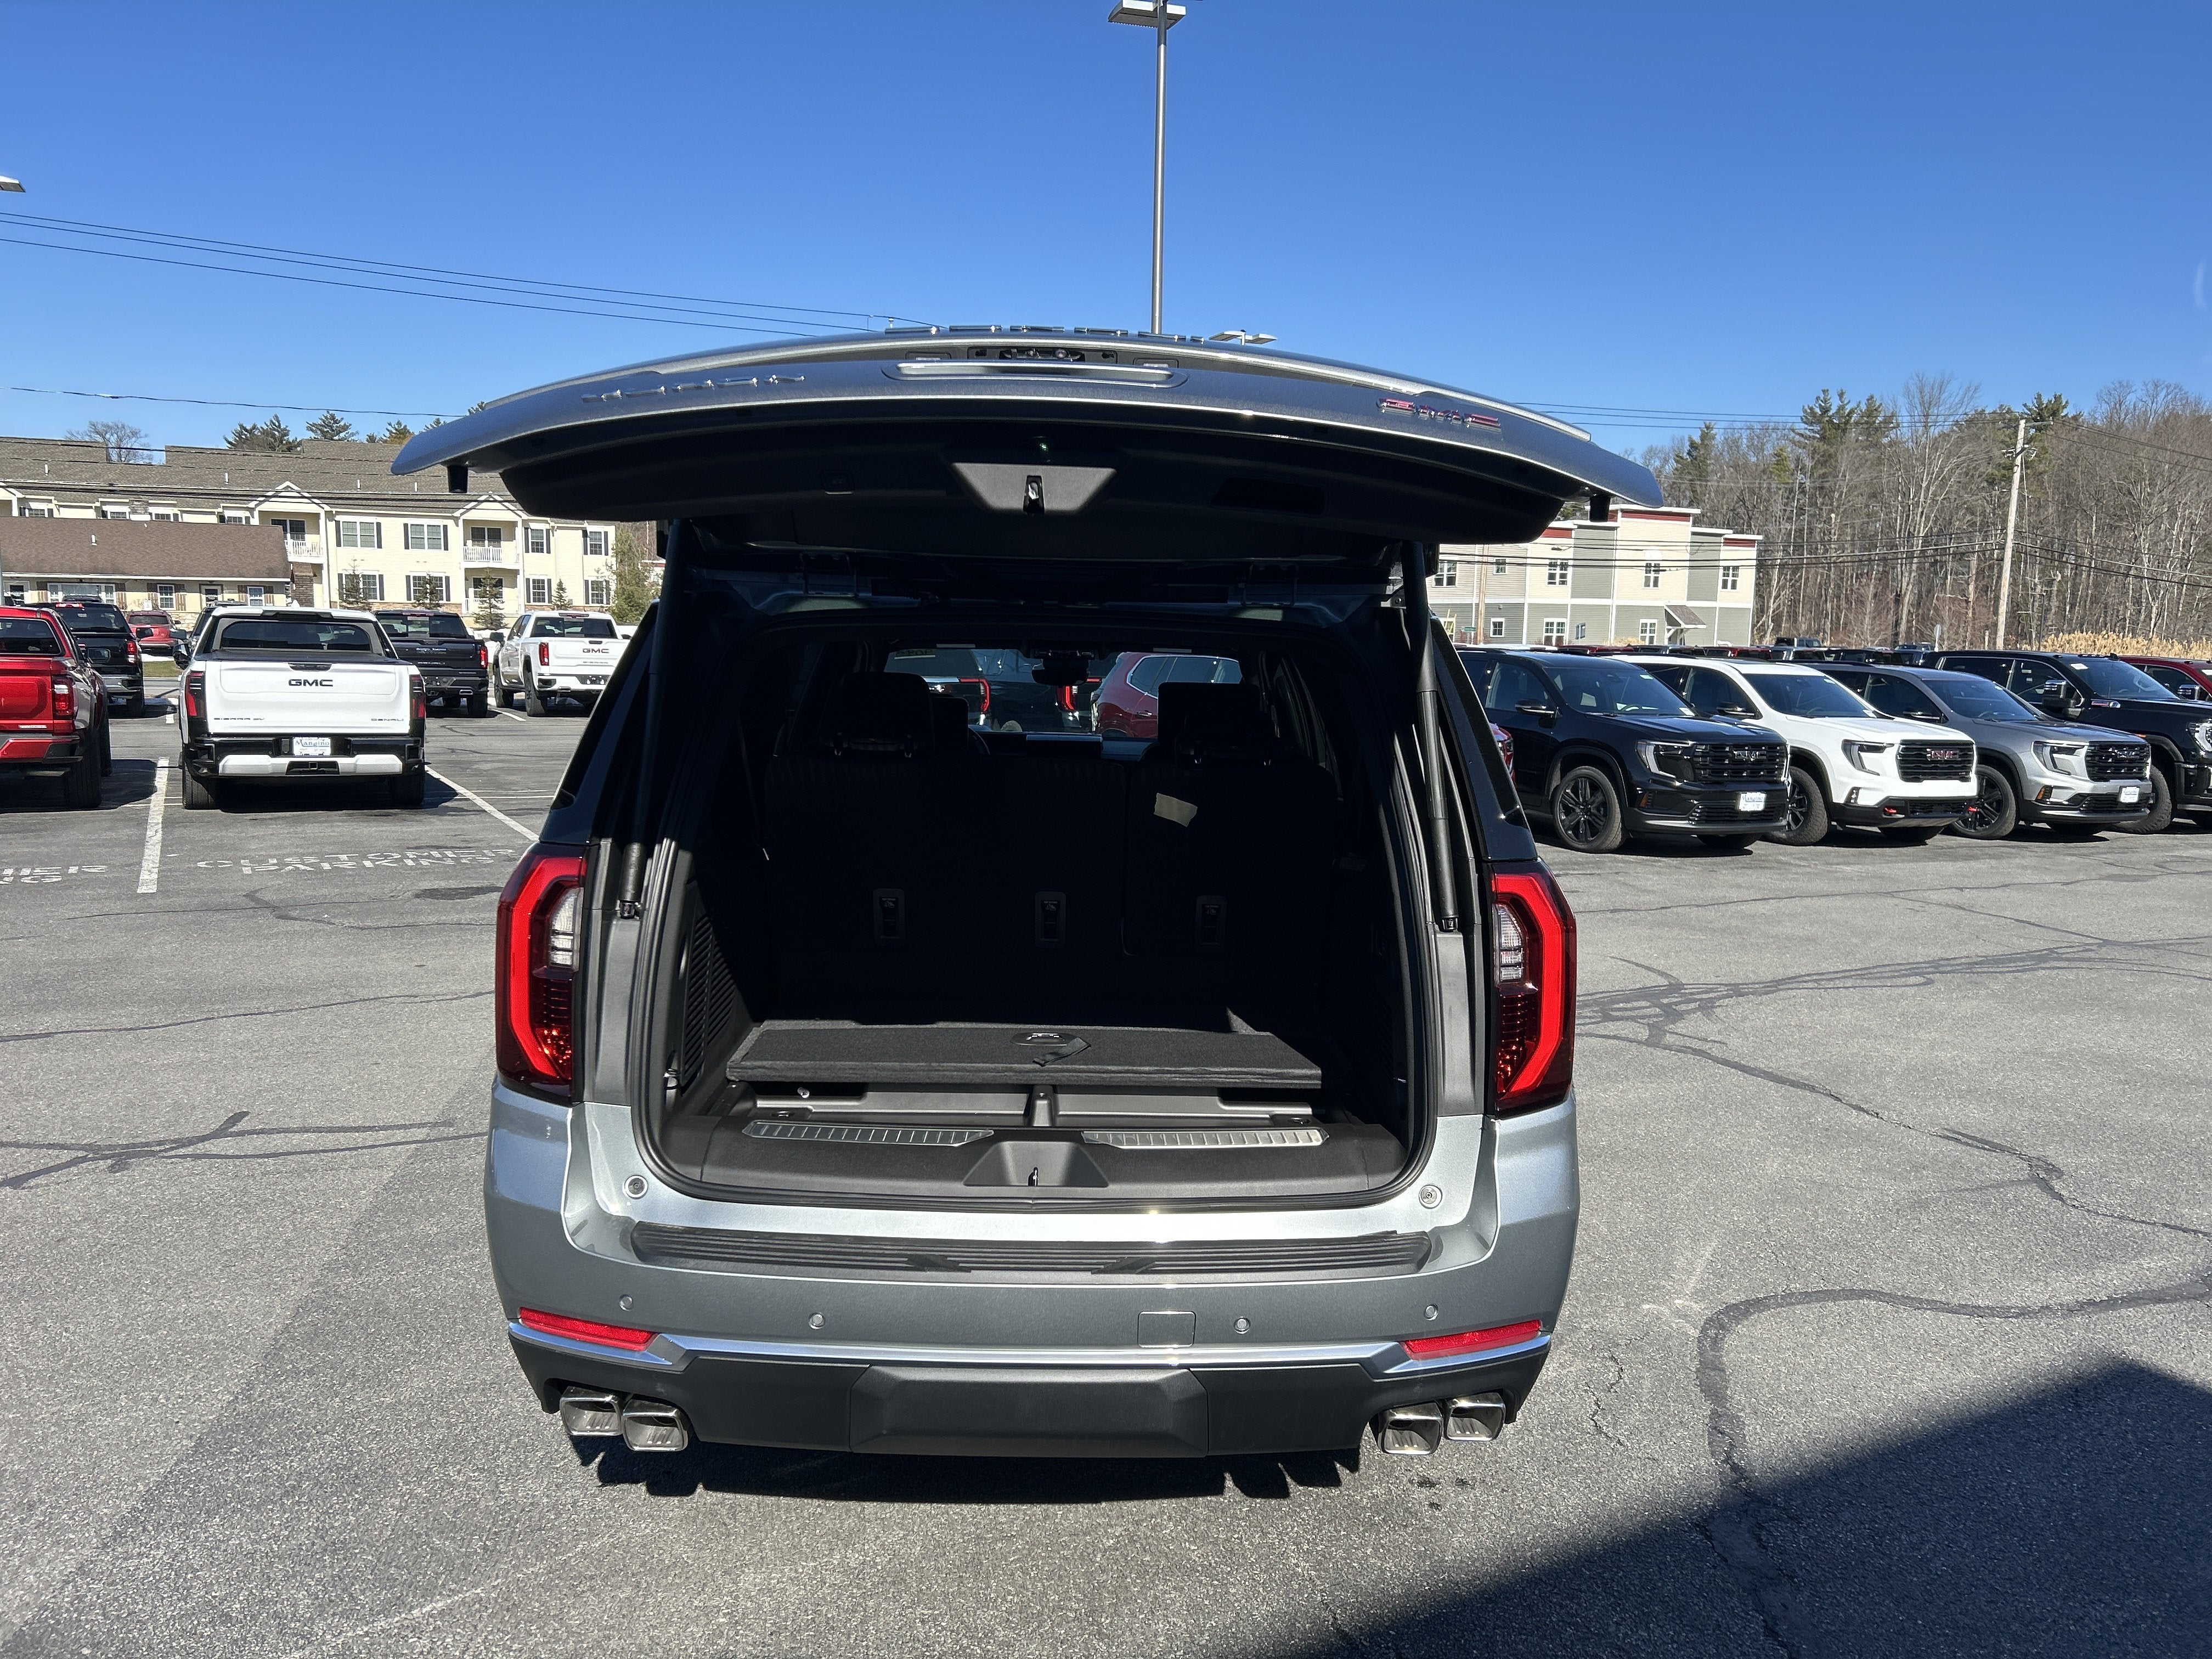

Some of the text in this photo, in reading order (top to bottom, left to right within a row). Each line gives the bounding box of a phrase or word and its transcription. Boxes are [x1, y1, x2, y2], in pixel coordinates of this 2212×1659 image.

[295, 739, 330, 747] Mangino
[197, 849, 518, 867] CUSTOMER
[242, 856, 495, 874] PARKING
